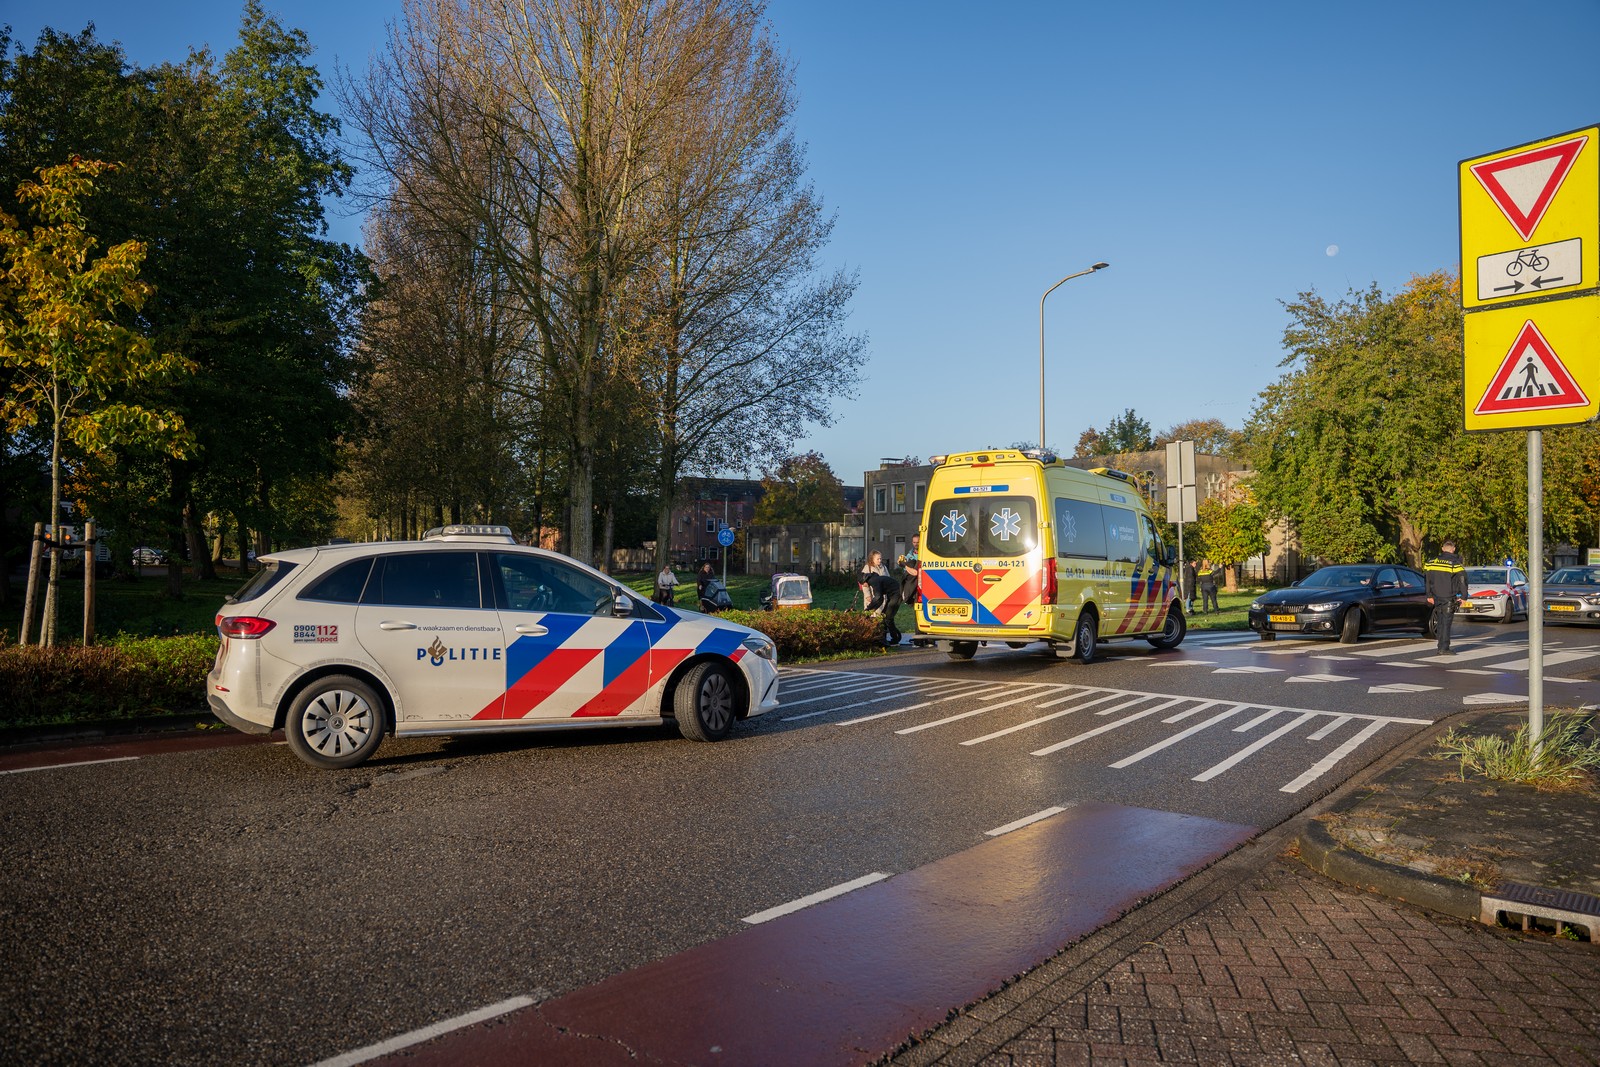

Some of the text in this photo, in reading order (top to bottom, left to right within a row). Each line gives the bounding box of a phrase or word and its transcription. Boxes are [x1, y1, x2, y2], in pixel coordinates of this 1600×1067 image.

[922, 560, 973, 568] AMBULANCE
[998, 560, 1025, 568] 04-121
[1065, 568, 1085, 578] 04-121
[1091, 569, 1127, 579] AMBULANCE
[316, 625, 338, 636] 112
